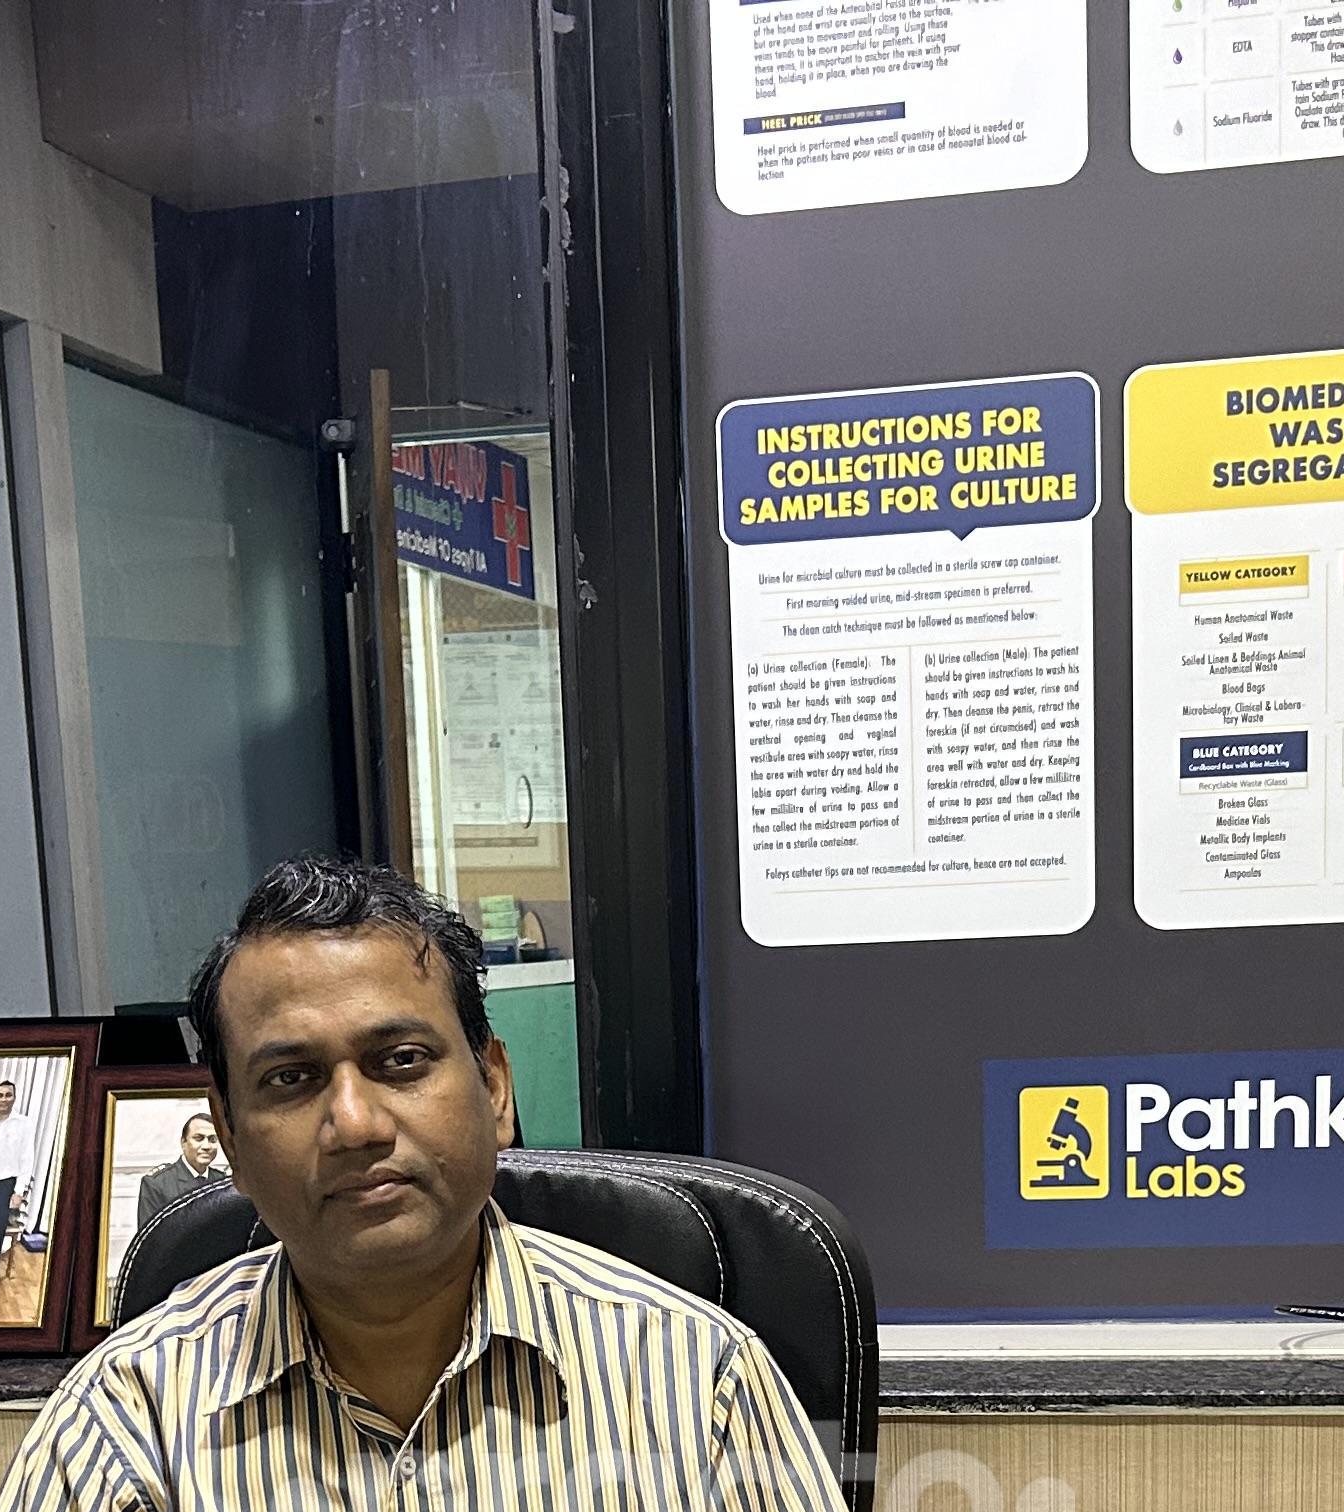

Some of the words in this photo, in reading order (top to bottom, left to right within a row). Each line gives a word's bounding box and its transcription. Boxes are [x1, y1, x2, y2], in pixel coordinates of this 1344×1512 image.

[1233, 41, 1252, 53] EDTA
[761, 117, 787, 130] HEEL
[790, 114, 822, 127] PRICK
[1213, 115, 1241, 128] Sodium
[1243, 110, 1272, 124] Fluoride
[757, 411, 971, 455] INSTRUCTIONS
[983, 407, 1042, 435] FOR
[768, 450, 944, 488] COLLECTING
[955, 442, 1045, 471] URINE
[741, 493, 870, 525] SAMPLES
[881, 486, 939, 514] FOR
[951, 473, 1077, 508] CULTURE
[1186, 570, 1231, 582] YELLOW
[1235, 566, 1296, 579] CATEGORY
[1195, 615, 1222, 626] Human
[1225, 612, 1267, 623] Anatomical
[1270, 610, 1293, 620] Waste
[1219, 632, 1243, 644] Soiled
[1246, 632, 1268, 641] Waste
[1222, 683, 1244, 694] Blood
[1246, 682, 1265, 693] Bags
[1192, 748, 1219, 758] BLUE
[1222, 743, 1283, 757] CATEGORY
[1219, 799, 1245, 809] Broken
[1248, 797, 1268, 807] Glass
[1216, 816, 1249, 826] Medicine
[1252, 814, 1270, 824] Vials
[1200, 834, 1229, 845] Metallic
[1232, 833, 1250, 845] Body
[1253, 832, 1286, 844] Implants
[1206, 851, 1257, 862] Contaminated
[1261, 849, 1280, 860] Glass
[1224, 868, 1261, 880] Ampoules
[1126, 1155, 1246, 1199] Labs
